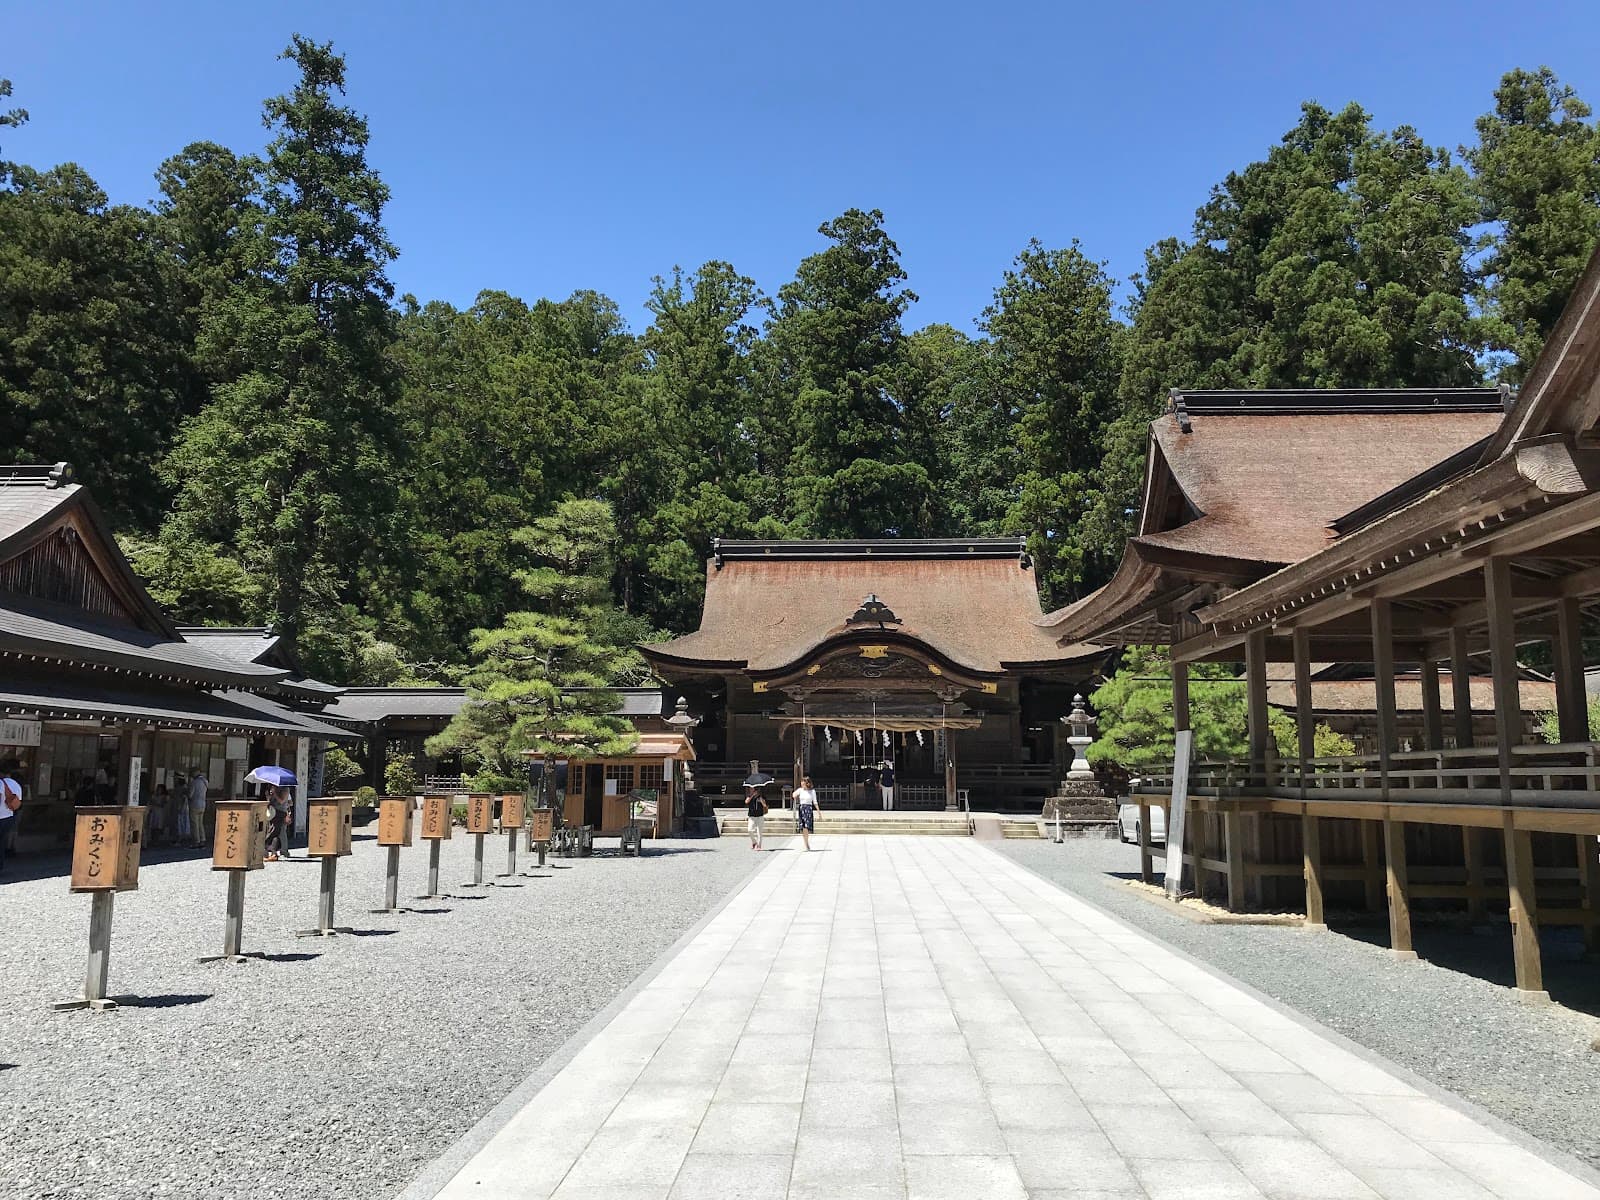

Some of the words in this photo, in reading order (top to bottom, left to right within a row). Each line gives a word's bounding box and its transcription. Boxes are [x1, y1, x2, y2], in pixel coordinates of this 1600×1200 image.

[318, 807, 329, 848] おみくじ
[428, 800, 439, 832] おみくじ
[474, 799, 483, 828] おみくじ
[88, 816, 108, 877] おみくじ
[226, 811, 240, 859] おみくじ
